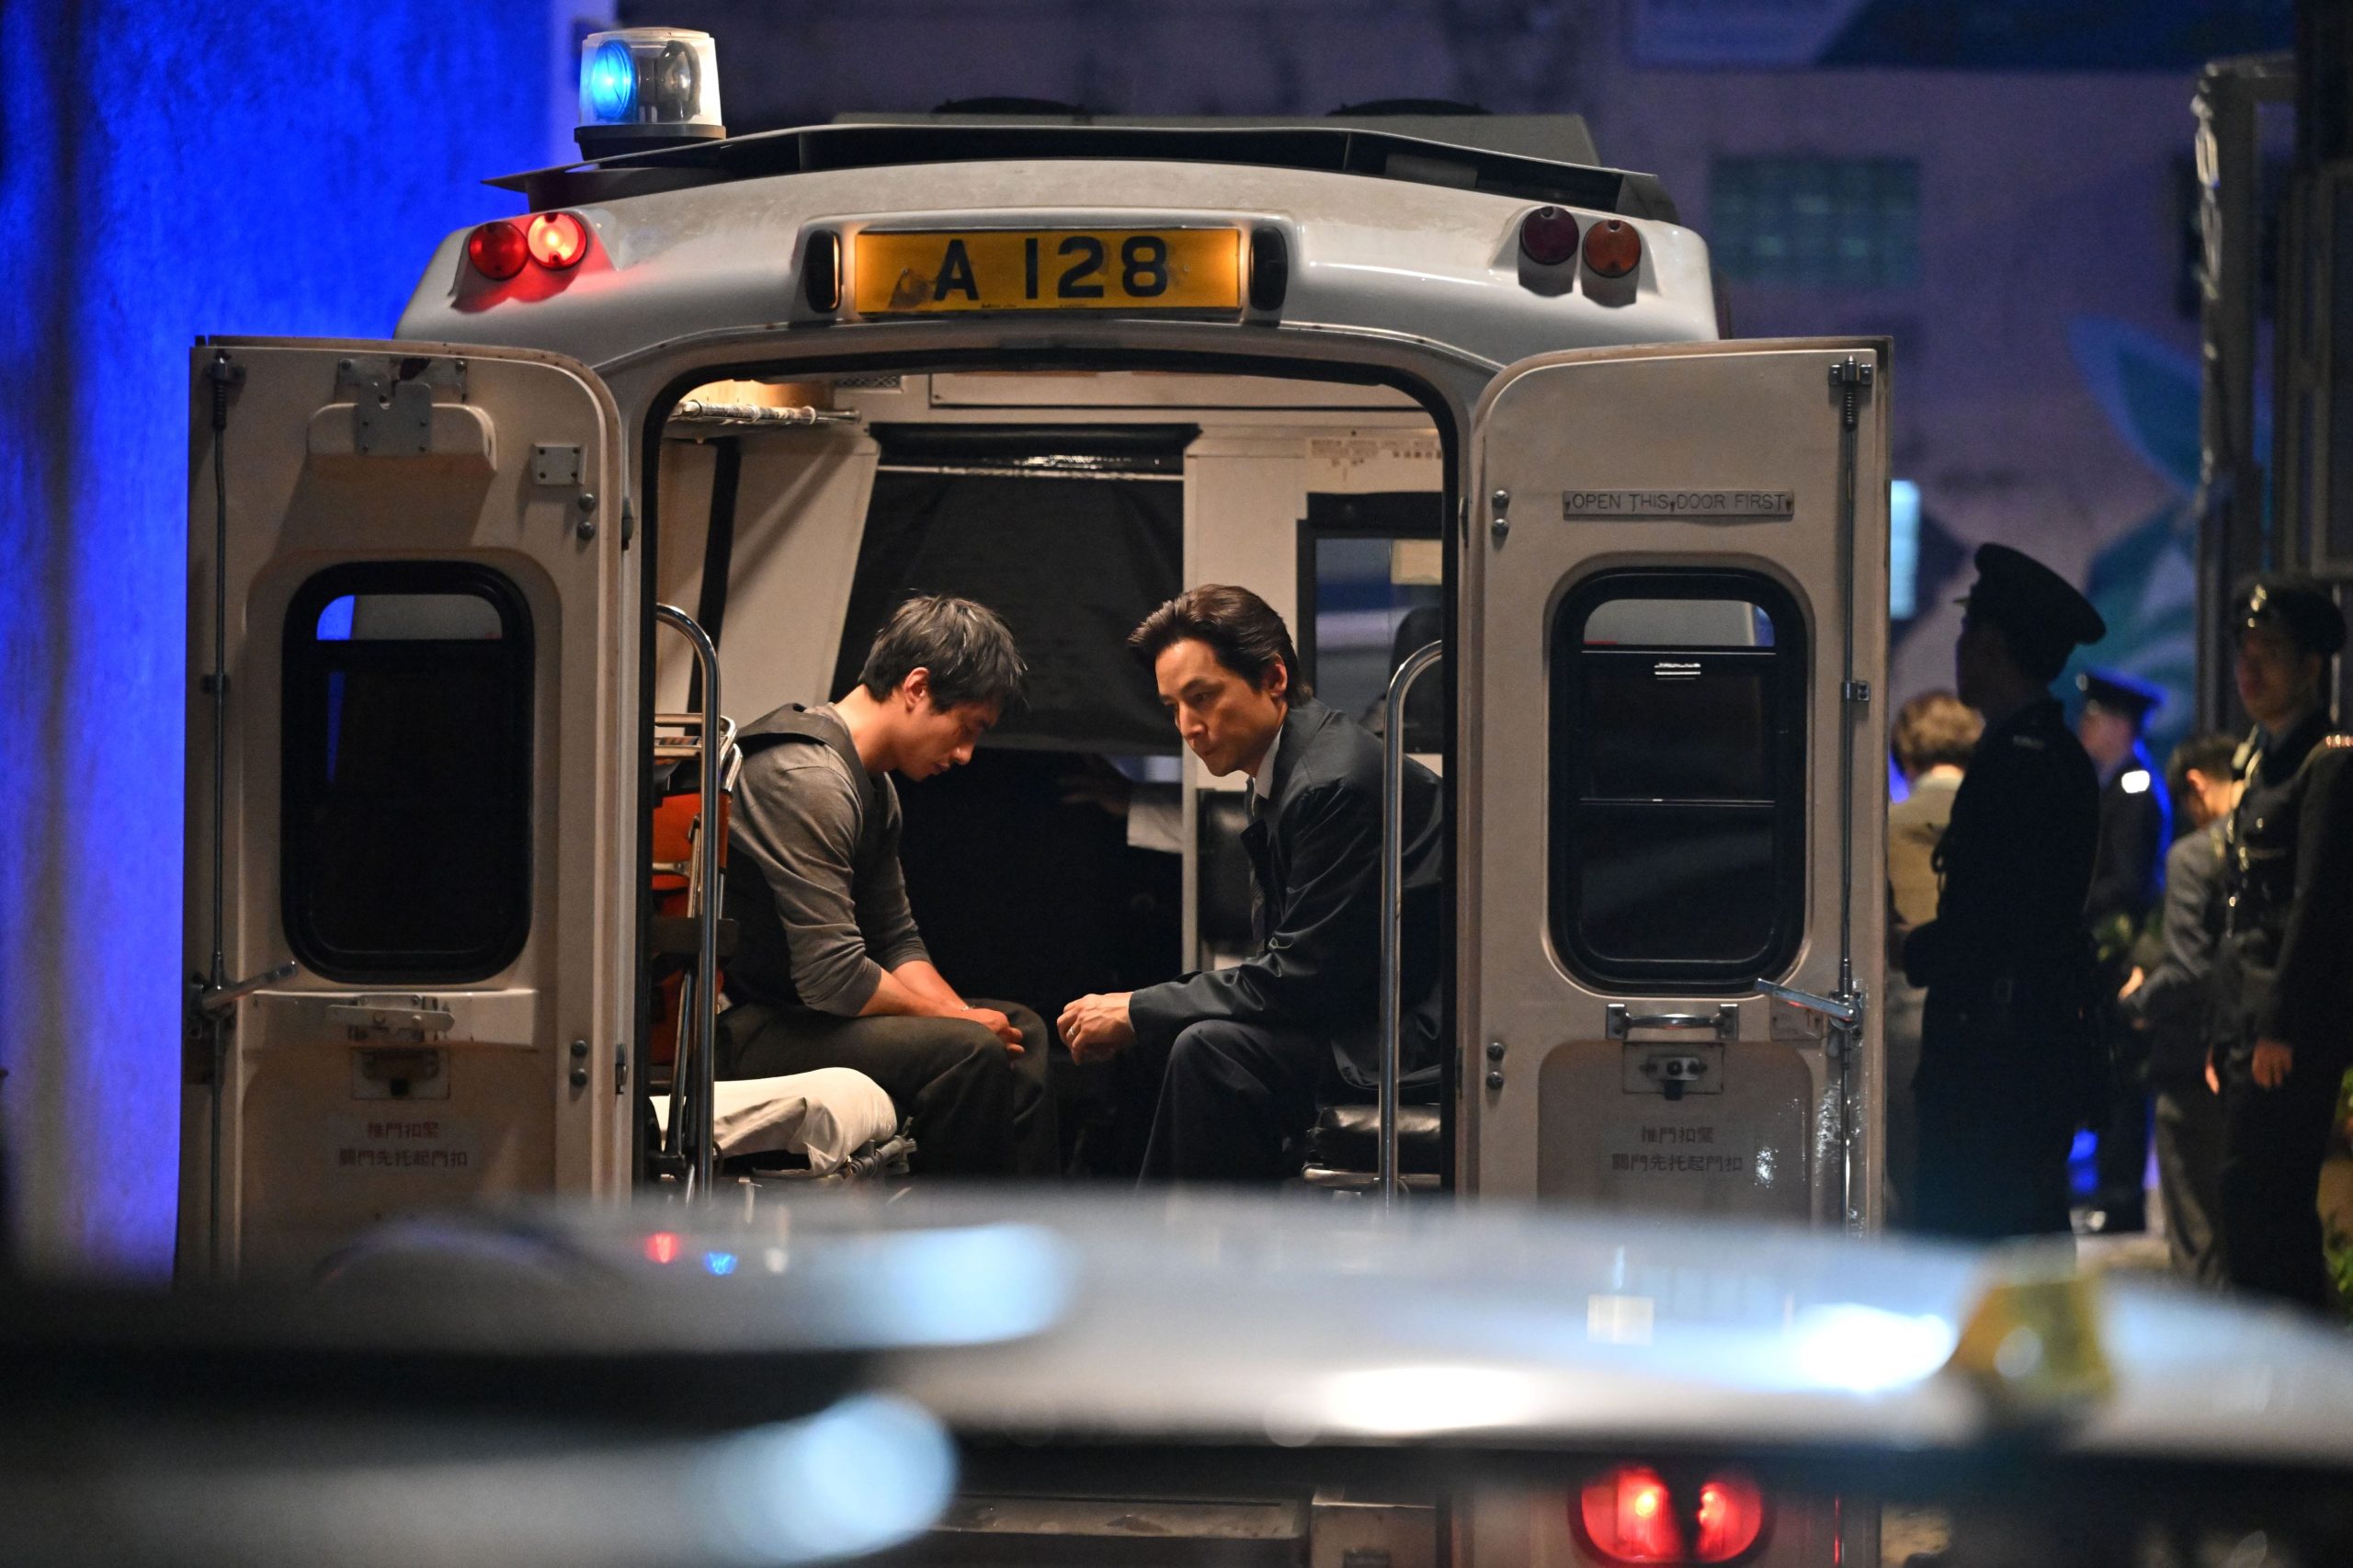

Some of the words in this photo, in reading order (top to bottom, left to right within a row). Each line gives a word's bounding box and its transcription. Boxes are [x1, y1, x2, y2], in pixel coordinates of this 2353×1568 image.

[934, 239, 981, 301] A
[1025, 236, 1168, 300] 128
[1572, 494, 1621, 510] OPEN
[1628, 494, 1670, 512] THIS
[1677, 494, 1726, 510] DOOR
[1734, 494, 1787, 511] FIRST
